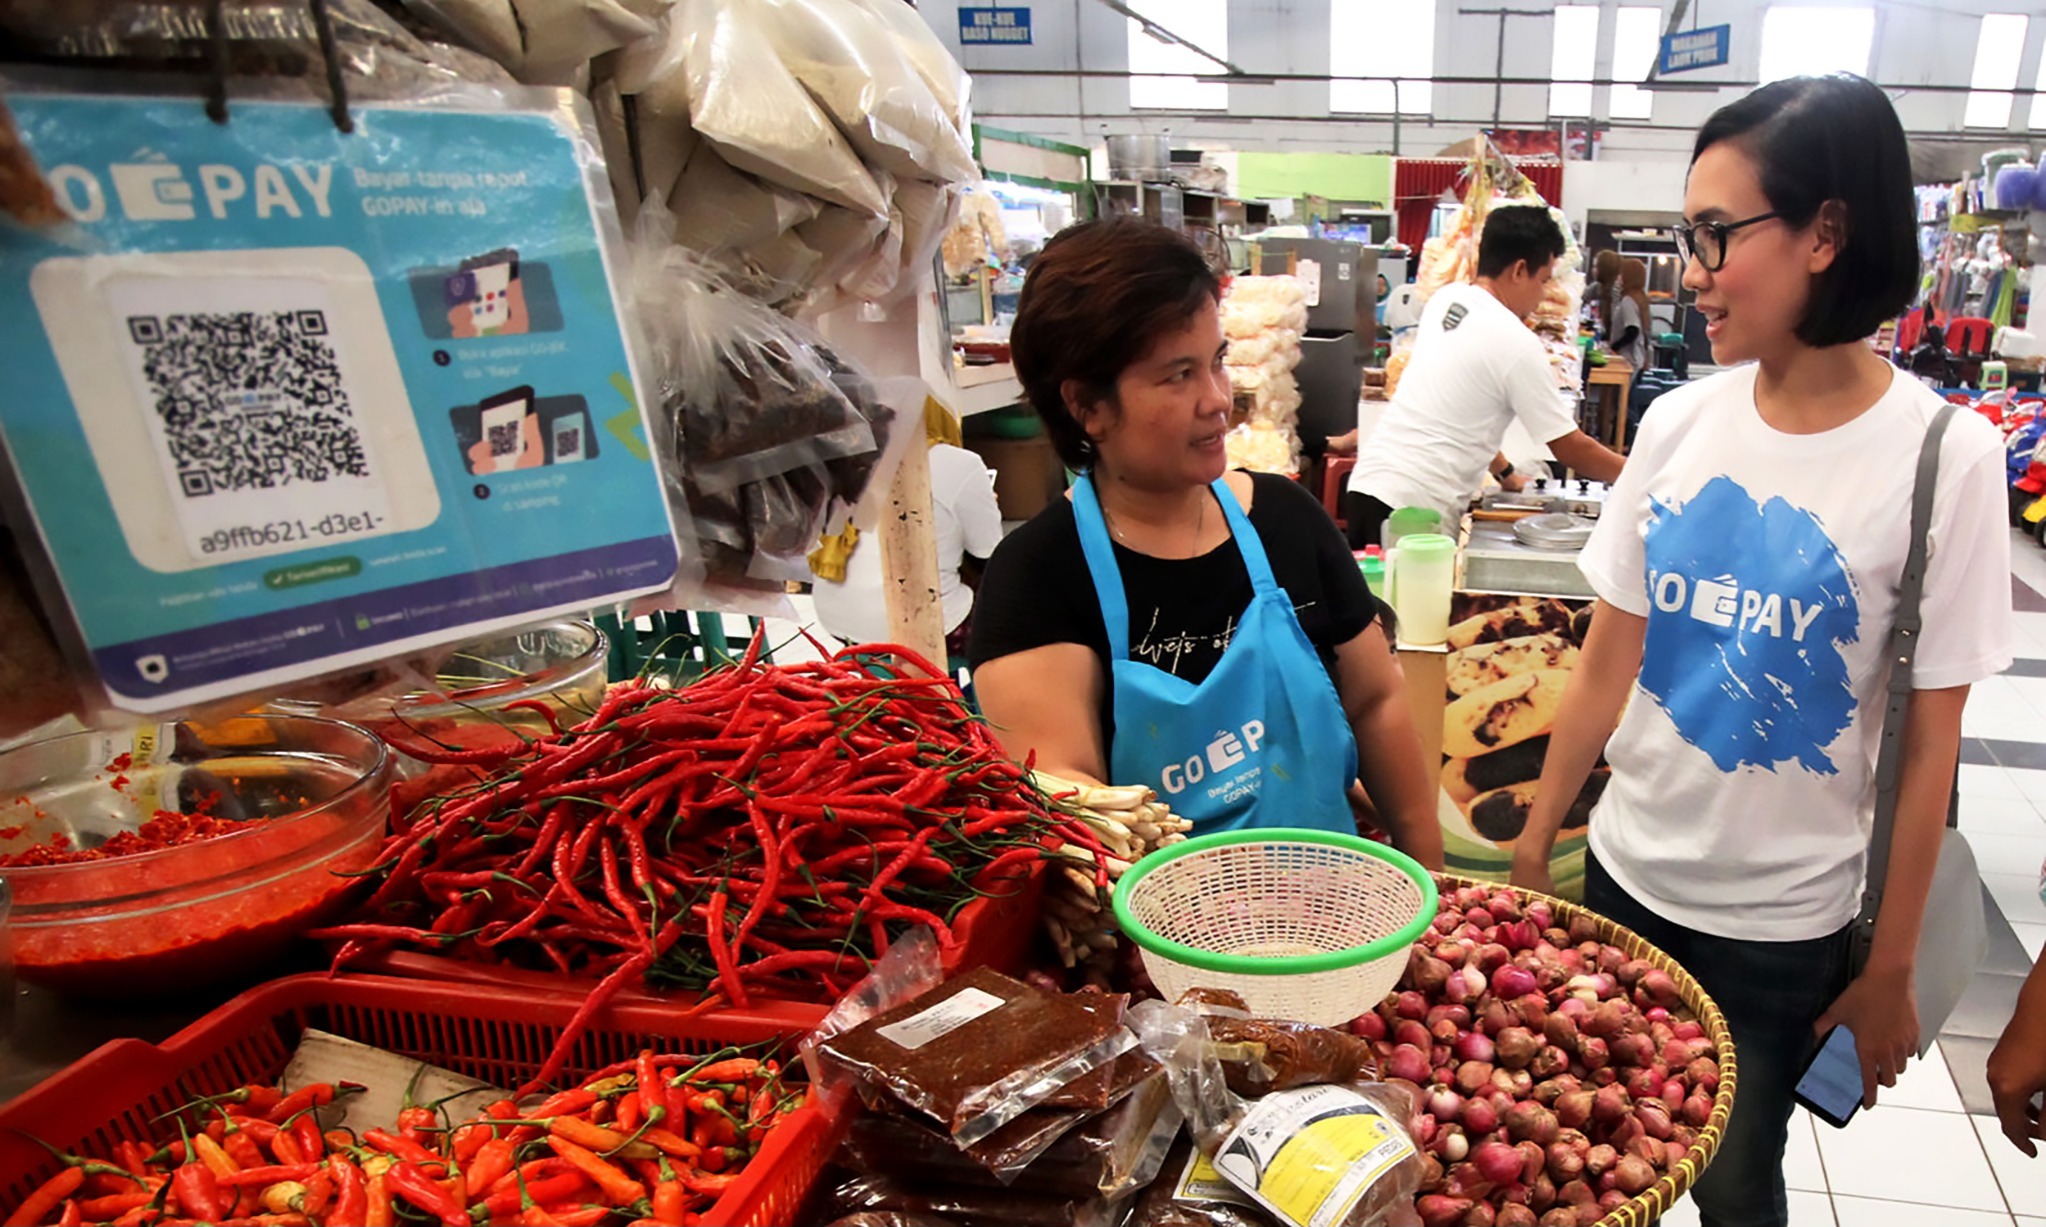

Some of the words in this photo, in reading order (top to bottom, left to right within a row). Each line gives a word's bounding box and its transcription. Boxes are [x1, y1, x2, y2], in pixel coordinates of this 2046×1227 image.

[48, 163, 107, 223] O
[198, 163, 333, 220] PAY
[199, 511, 384, 554] a9ffb621-d3e1-
[1739, 590, 1824, 642] PAY
[1161, 755, 1204, 794] GO
